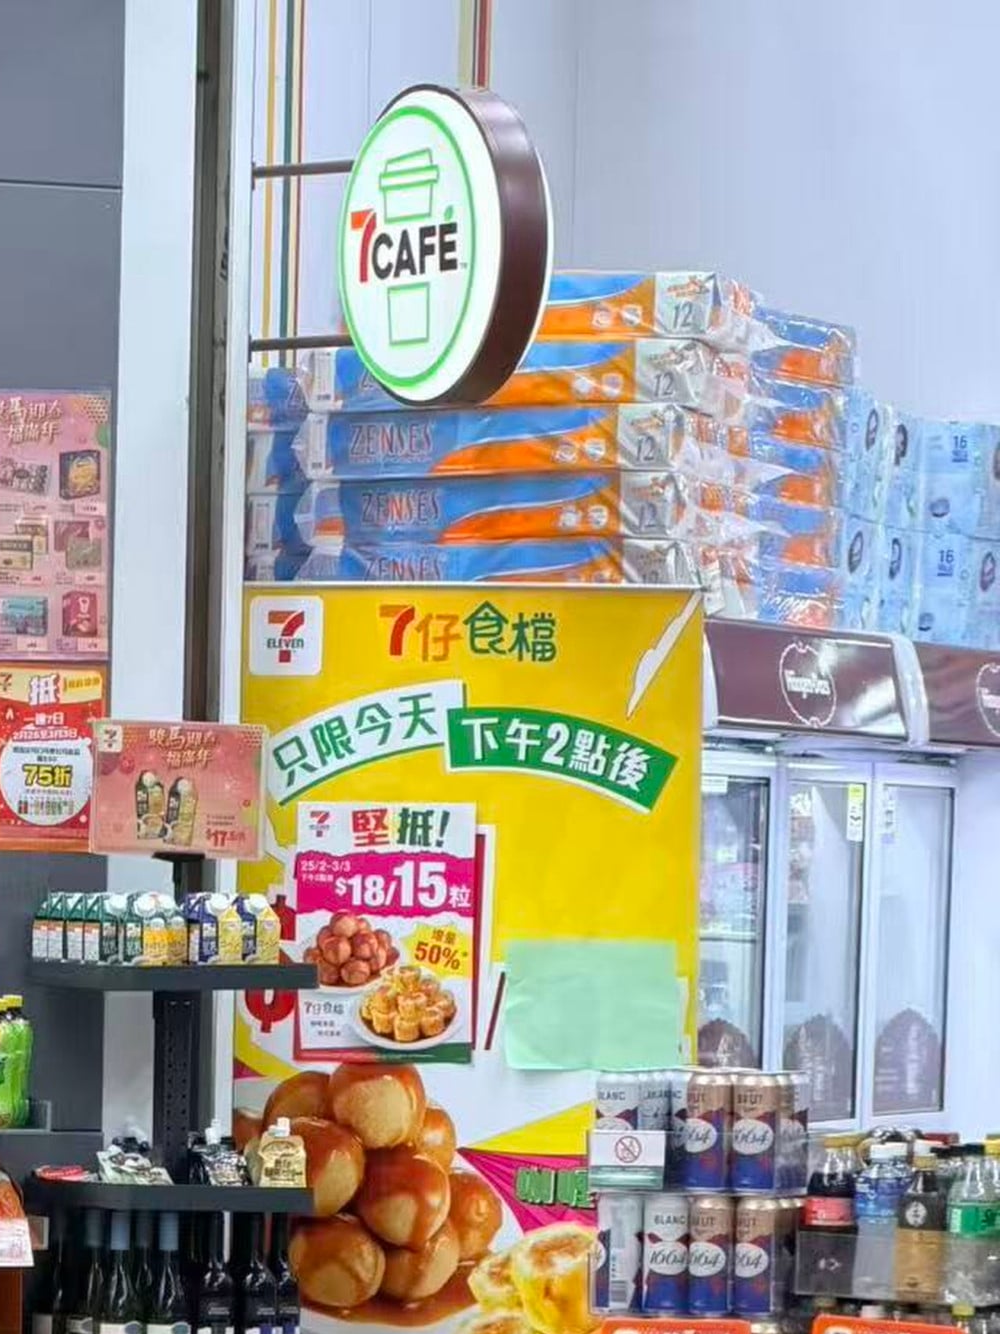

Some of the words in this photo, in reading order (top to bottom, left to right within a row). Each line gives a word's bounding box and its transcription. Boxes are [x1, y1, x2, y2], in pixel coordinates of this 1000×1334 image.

[673, 302, 693, 328] 12
[654, 372, 676, 397] 12
[351, 423, 432, 459] ZENSES
[635, 436, 657, 461] 12
[953, 435, 967, 449] 16
[362, 490, 440, 524] ZENSES
[940, 549, 954, 563] 16
[379, 601, 557, 663] 7仔食檔
[273, 692, 437, 787] 只限今天
[461, 717, 652, 792] 下午2點後
[22, 764, 73, 788] 75折
[301, 861, 351, 872] 25/2-3/3
[654, 1215, 686, 1226] BLANC
